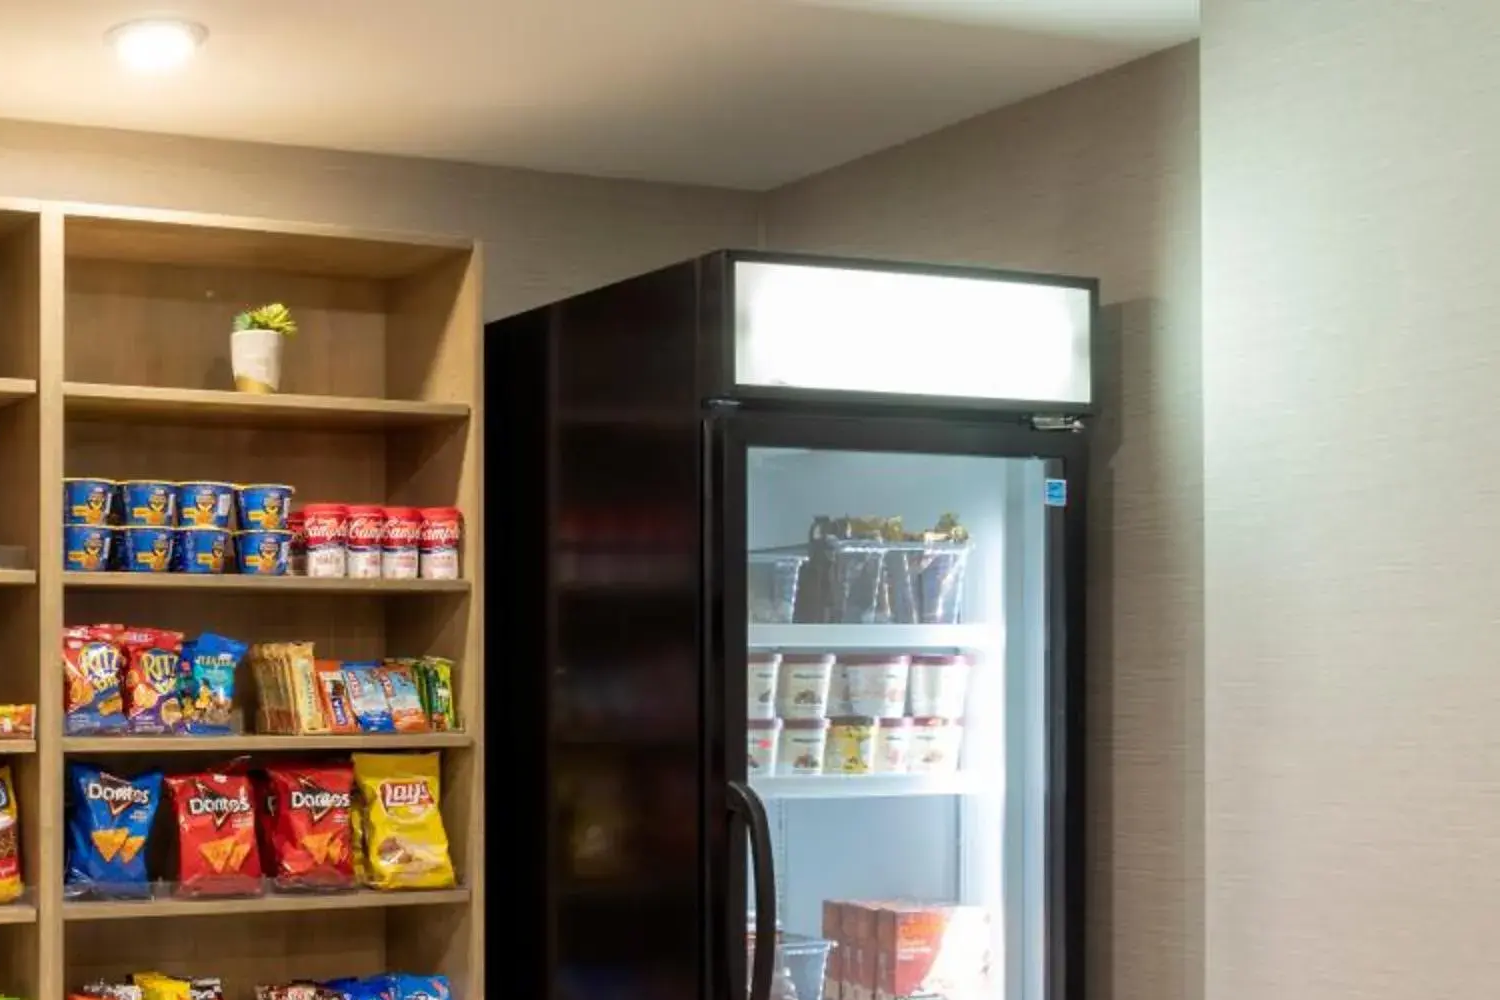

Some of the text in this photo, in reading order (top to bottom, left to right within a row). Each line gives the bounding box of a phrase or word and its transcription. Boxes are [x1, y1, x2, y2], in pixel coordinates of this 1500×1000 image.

[87, 782, 150, 804] Doritos
[290, 791, 351, 809] Doritos
[189, 797, 250, 814] Doritos
